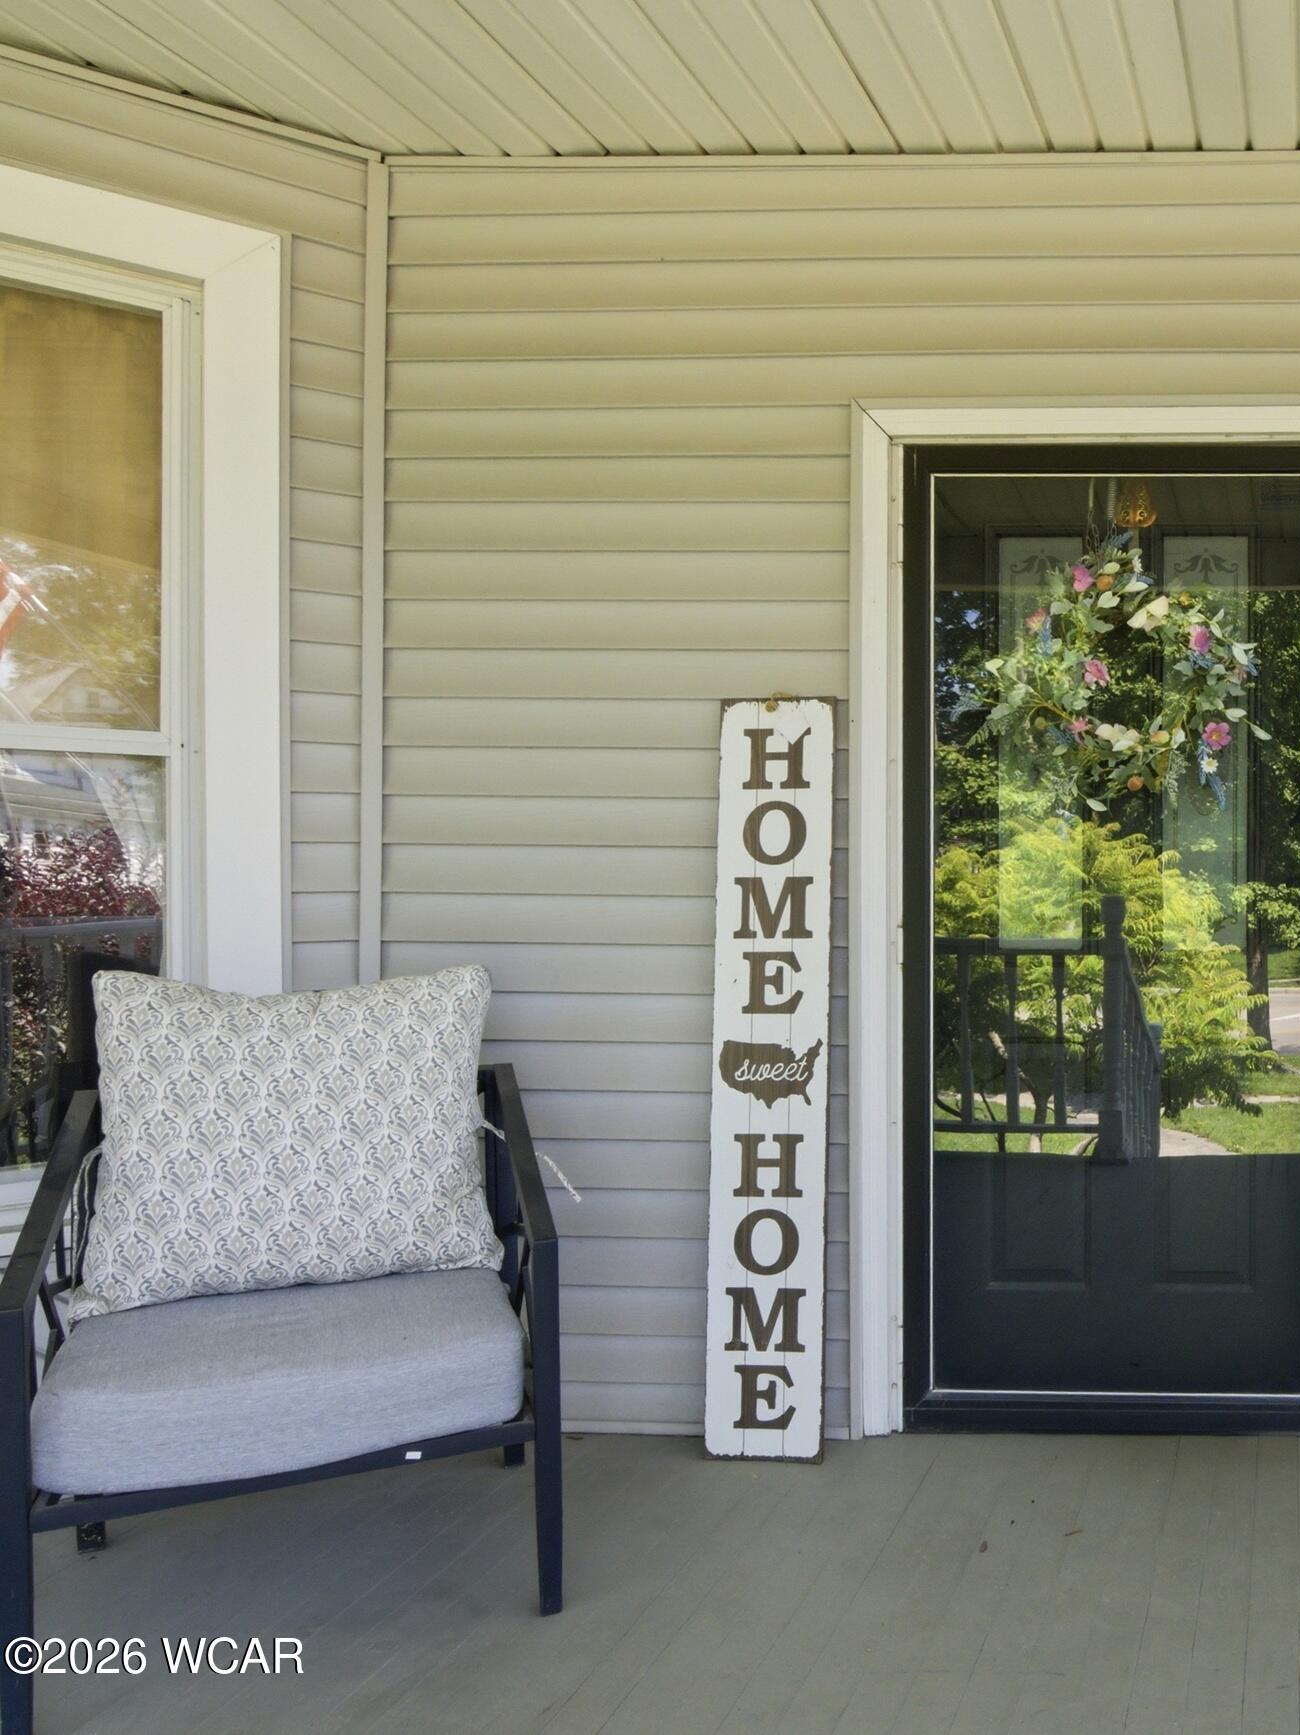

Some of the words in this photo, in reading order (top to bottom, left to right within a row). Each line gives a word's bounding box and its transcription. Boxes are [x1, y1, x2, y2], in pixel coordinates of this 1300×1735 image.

[732, 726, 814, 1015] HOME
[734, 1056, 809, 1081] sweet
[724, 1133, 807, 1431] HOME
